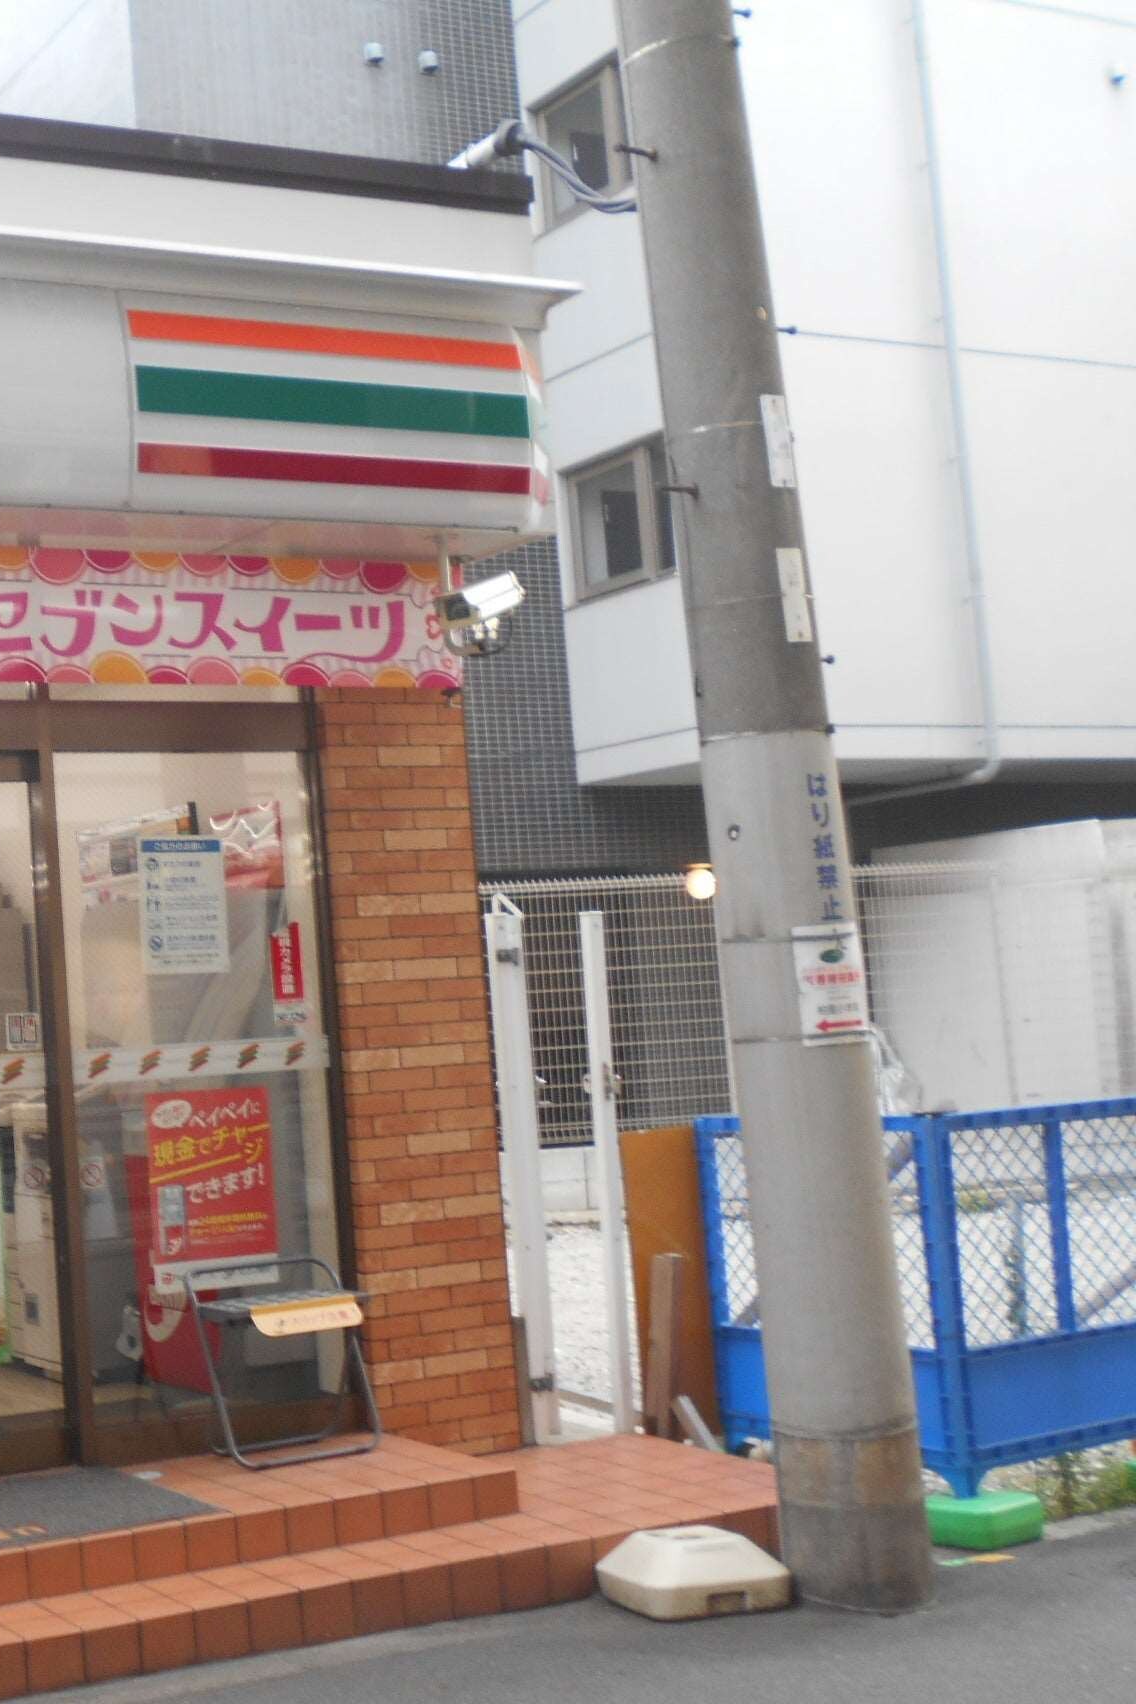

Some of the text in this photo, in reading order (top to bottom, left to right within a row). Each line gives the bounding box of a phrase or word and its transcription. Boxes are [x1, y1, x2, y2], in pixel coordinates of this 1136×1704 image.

[806, 773, 844, 922] はり紙禁止
